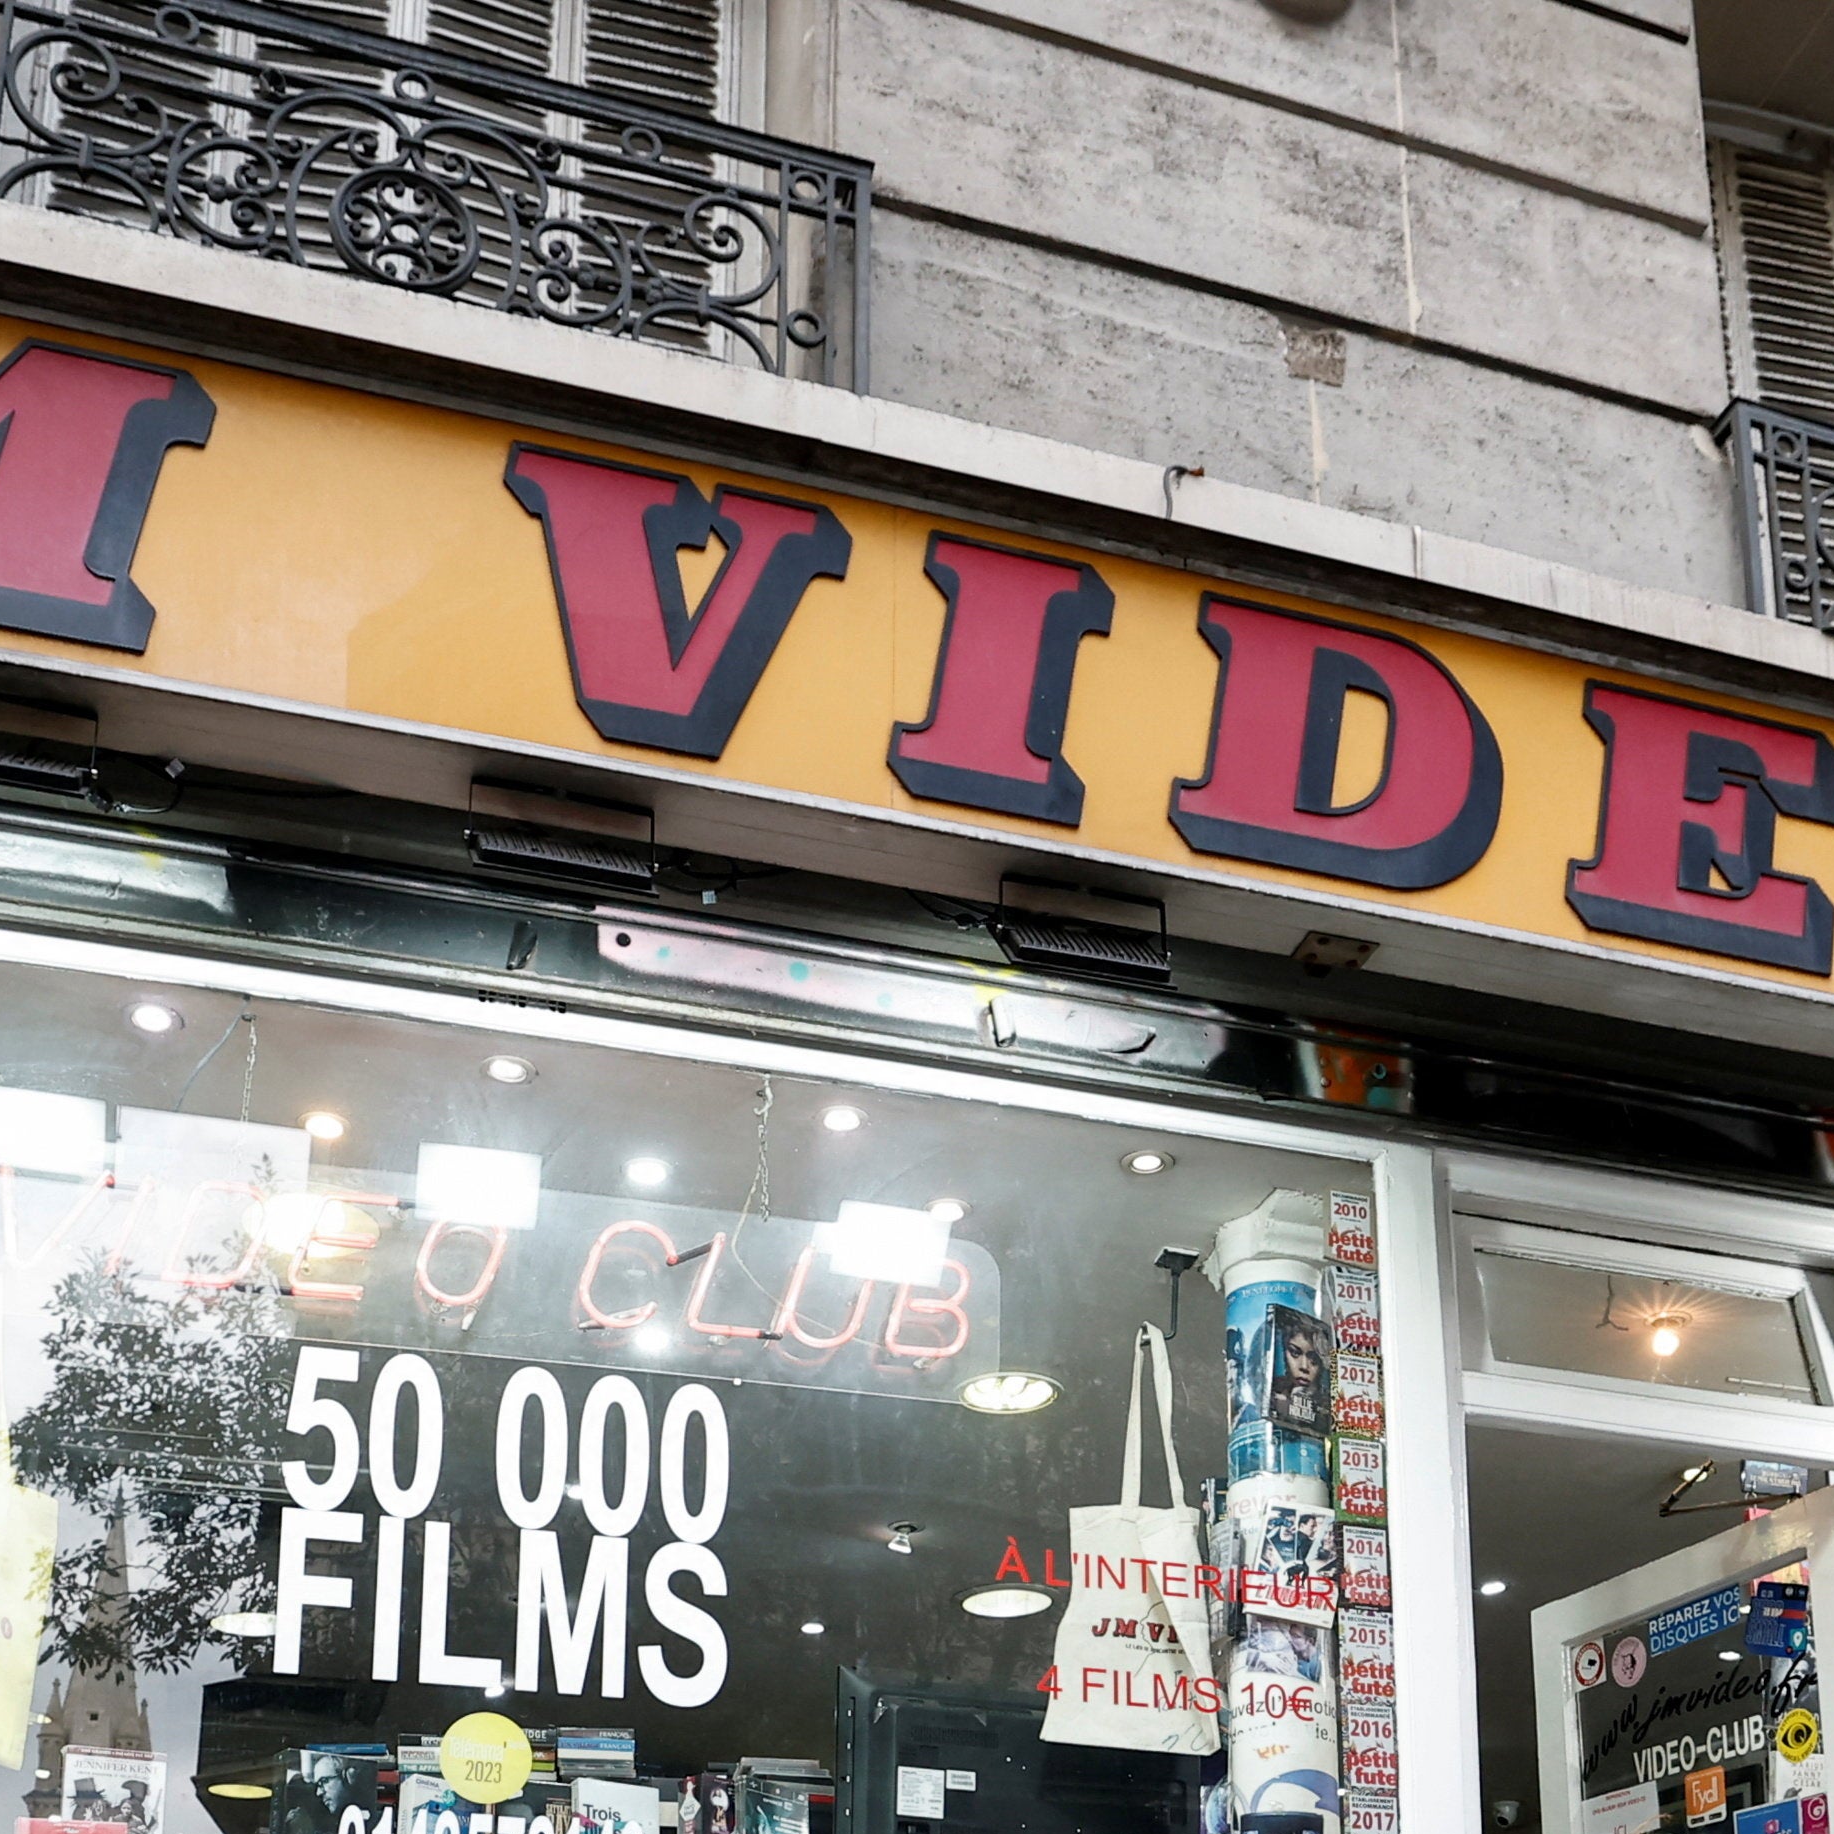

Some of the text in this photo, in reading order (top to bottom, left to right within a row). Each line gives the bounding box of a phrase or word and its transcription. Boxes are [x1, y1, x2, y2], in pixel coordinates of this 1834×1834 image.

[1334, 1202, 1367, 1219] 2010
[577, 1220, 969, 1358] CLUB
[1337, 1284, 1373, 1301] 2011
[1340, 1366, 1375, 1384] 2012
[282, 1346, 729, 1544] 50 000
[1342, 1450, 1380, 1469] 2013
[1346, 1538, 1384, 1557] 2014
[995, 1536, 1337, 1612] À L'INTERIEUR
[274, 1509, 727, 1707] FILMS
[1648, 1586, 1741, 1636] RÉPAREZ VOS
[1348, 1626, 1387, 1646] 2015
[1649, 1615, 1719, 1653] DISQUES
[1036, 1665, 1314, 1722] 4 FILMS 10€
[1350, 1719, 1392, 1738] 2016
[1632, 1714, 1765, 1784] VIDEO-CLUB
[465, 1760, 502, 1784] 2023
[583, 1804, 622, 1823] Trois
[1351, 1811, 1395, 1831] 2017
